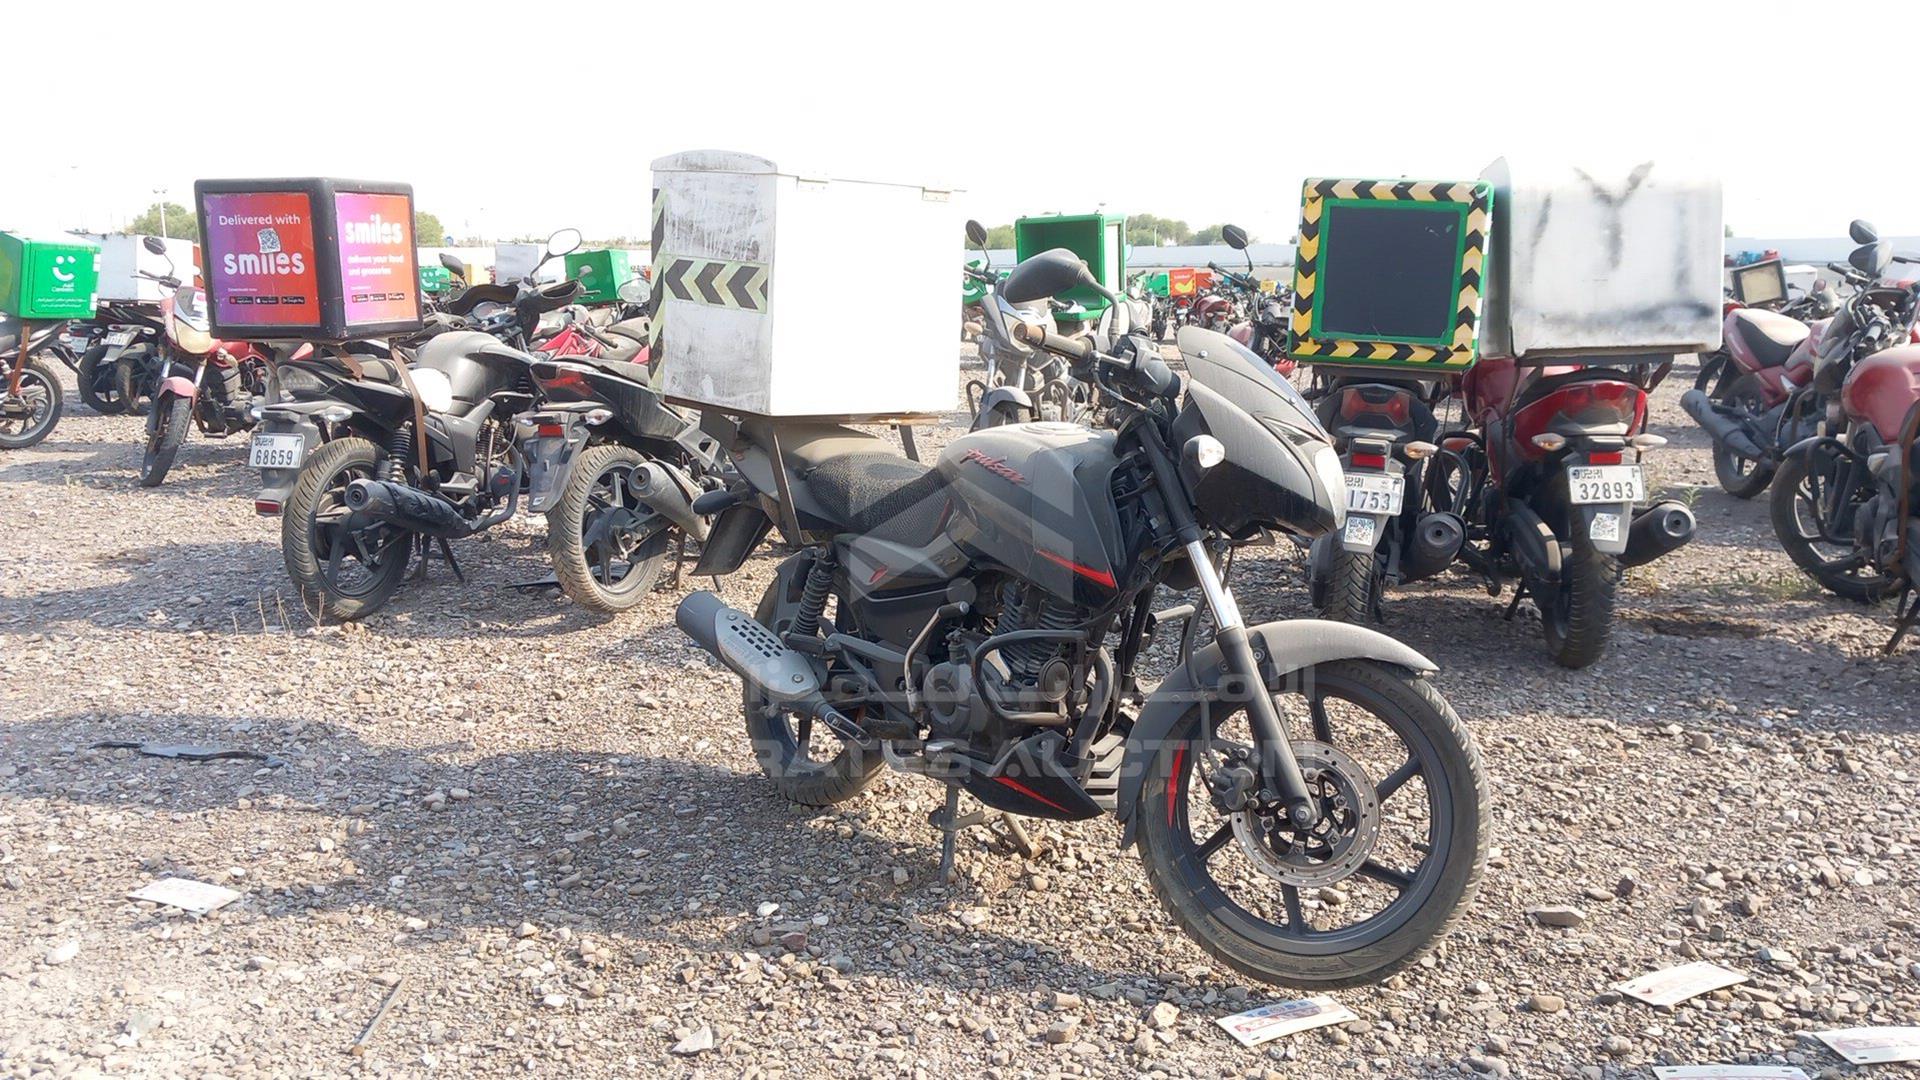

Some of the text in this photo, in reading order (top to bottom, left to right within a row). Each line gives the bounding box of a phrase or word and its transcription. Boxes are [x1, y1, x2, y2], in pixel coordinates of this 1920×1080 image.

[219, 213, 300, 226] Delivered with
[345, 213, 403, 244] smiles
[224, 252, 305, 275] smiles
[255, 449, 294, 466] 68659
[1350, 489, 1391, 511] 1753
[1579, 481, 1635, 501] 32893
